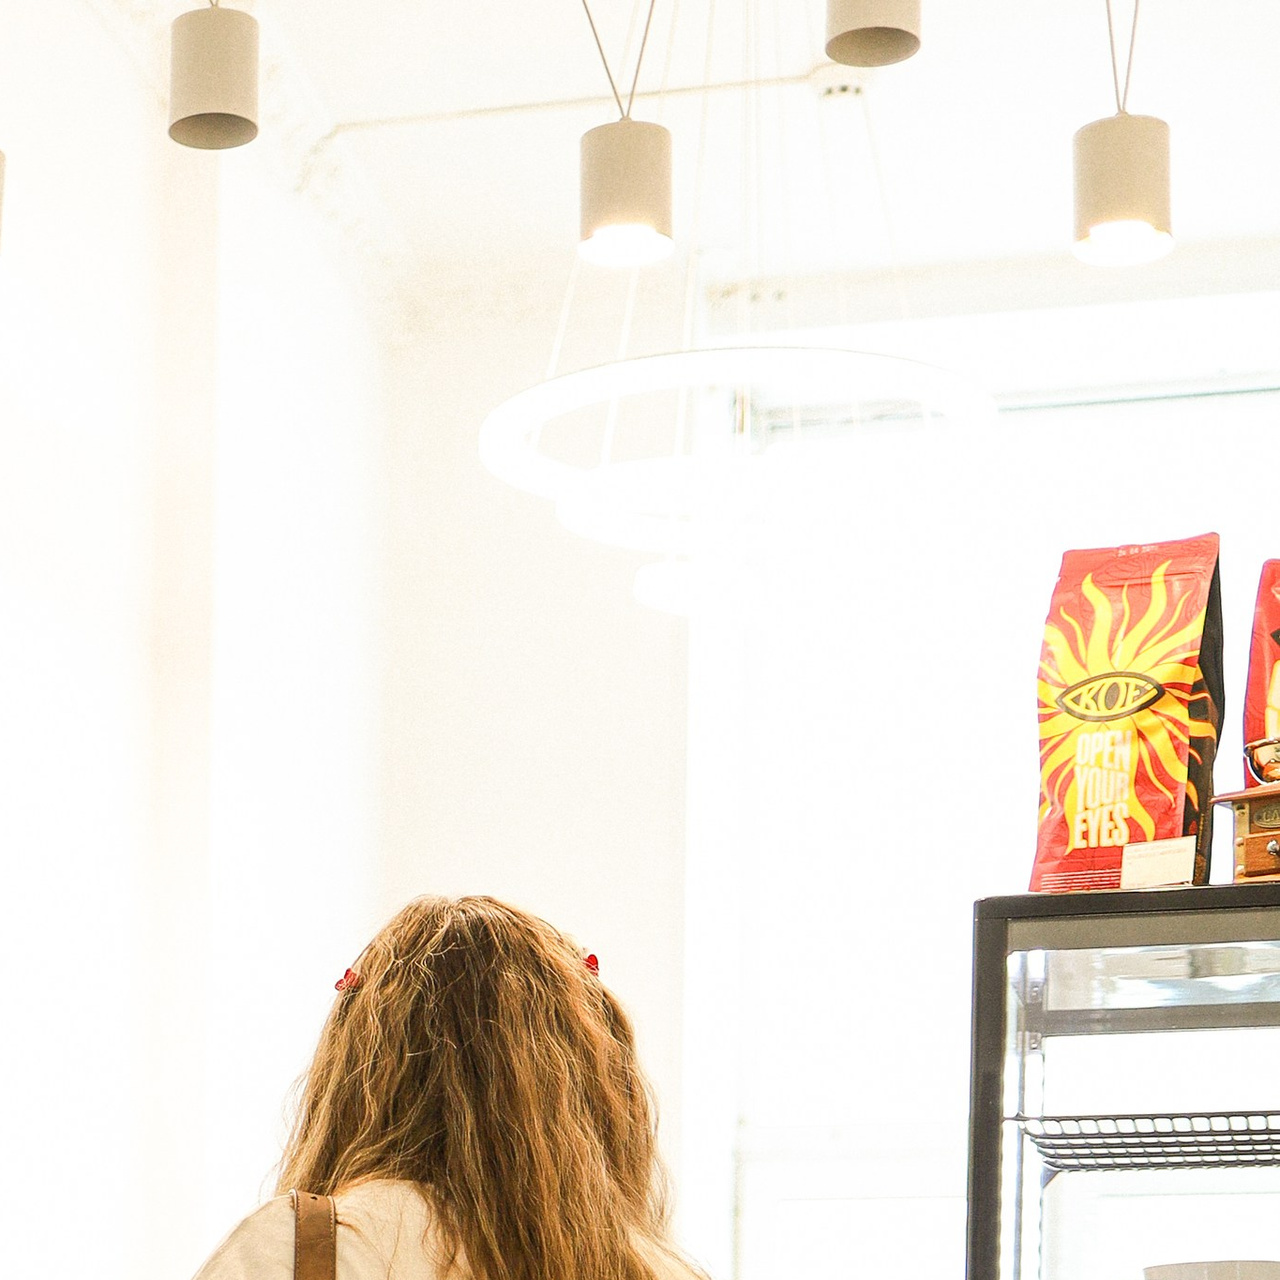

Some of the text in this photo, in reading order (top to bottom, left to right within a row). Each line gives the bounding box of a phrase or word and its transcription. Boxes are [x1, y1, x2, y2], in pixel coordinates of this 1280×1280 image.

[1075, 730, 1131, 772] OPEN
[1074, 765, 1129, 814] YOUR
[1074, 802, 1130, 849] EYES
